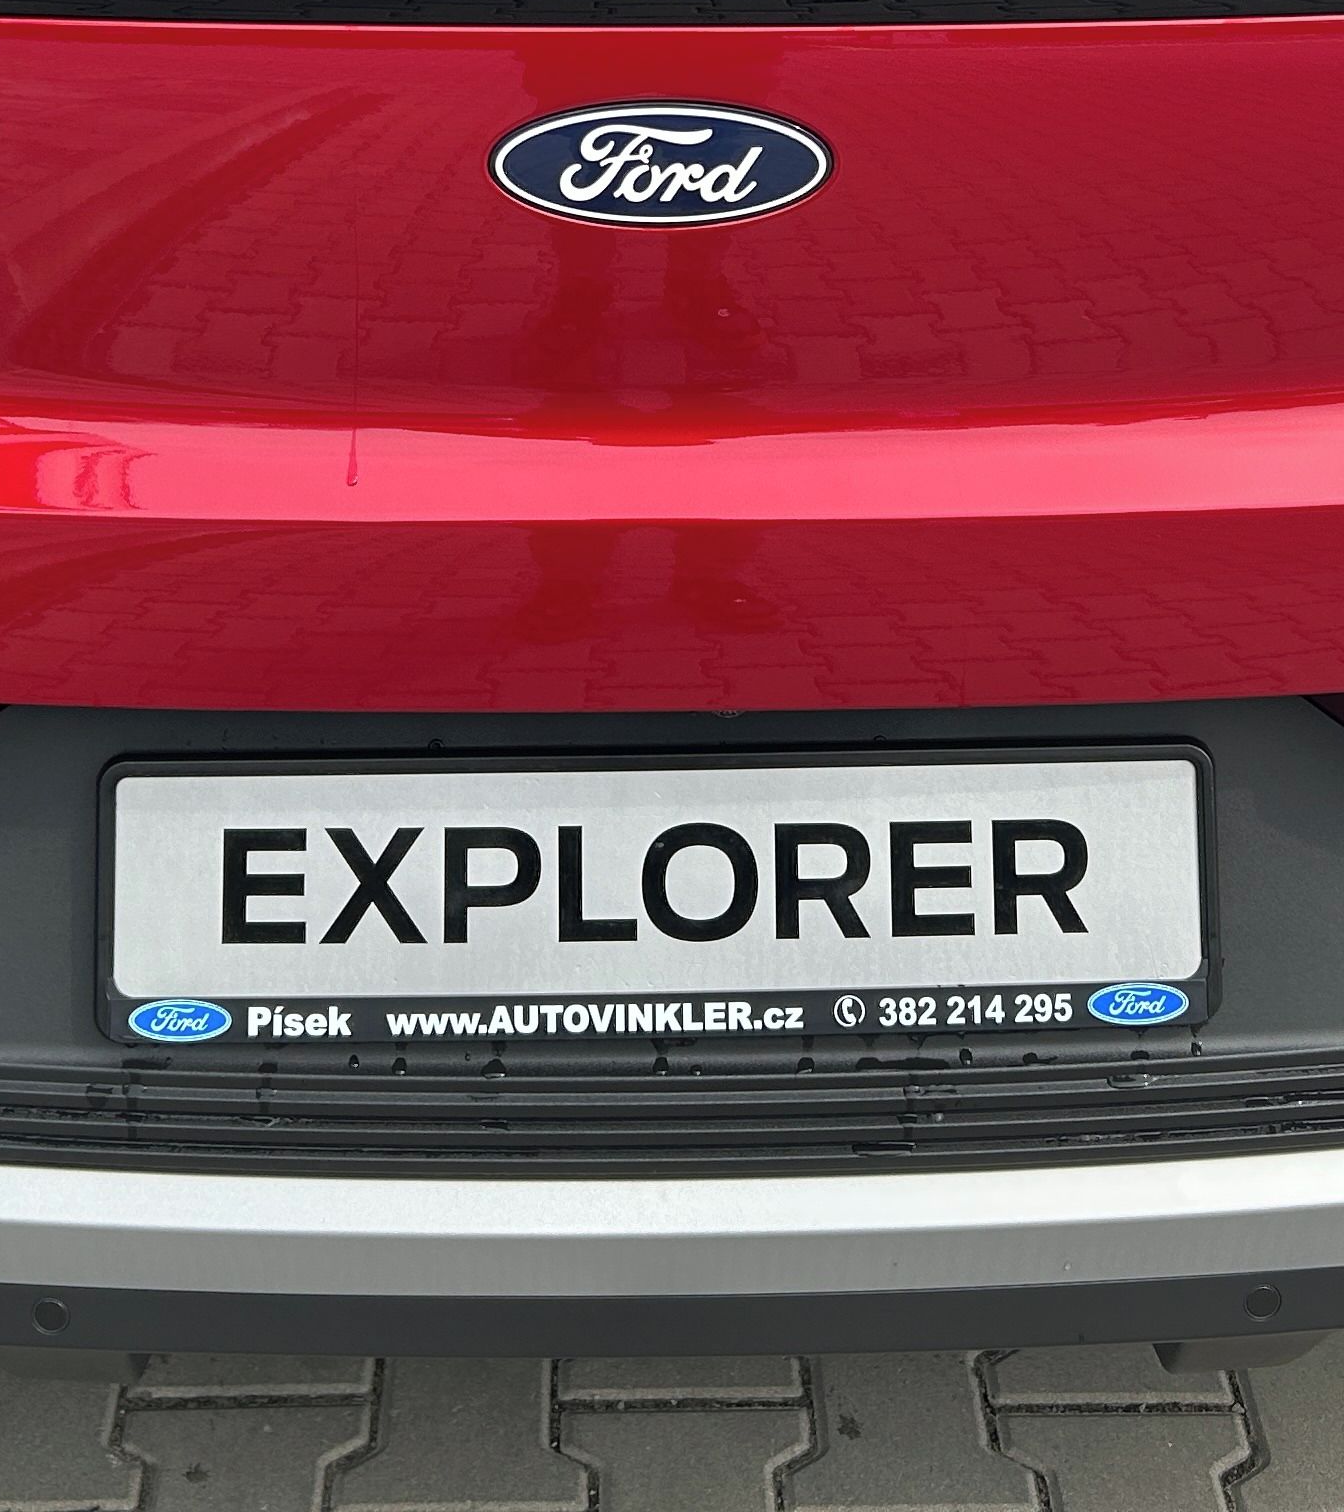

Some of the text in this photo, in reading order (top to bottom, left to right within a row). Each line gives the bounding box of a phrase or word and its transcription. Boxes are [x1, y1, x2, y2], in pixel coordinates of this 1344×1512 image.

[559, 123, 764, 204] Ford
[220, 818, 1090, 946] EXPLORER
[150, 1006, 209, 1033] Ford
[247, 993, 1073, 1037] Písek www.AUTOVINKLER.cz 382 214 295
[1108, 990, 1167, 1016] Ford
